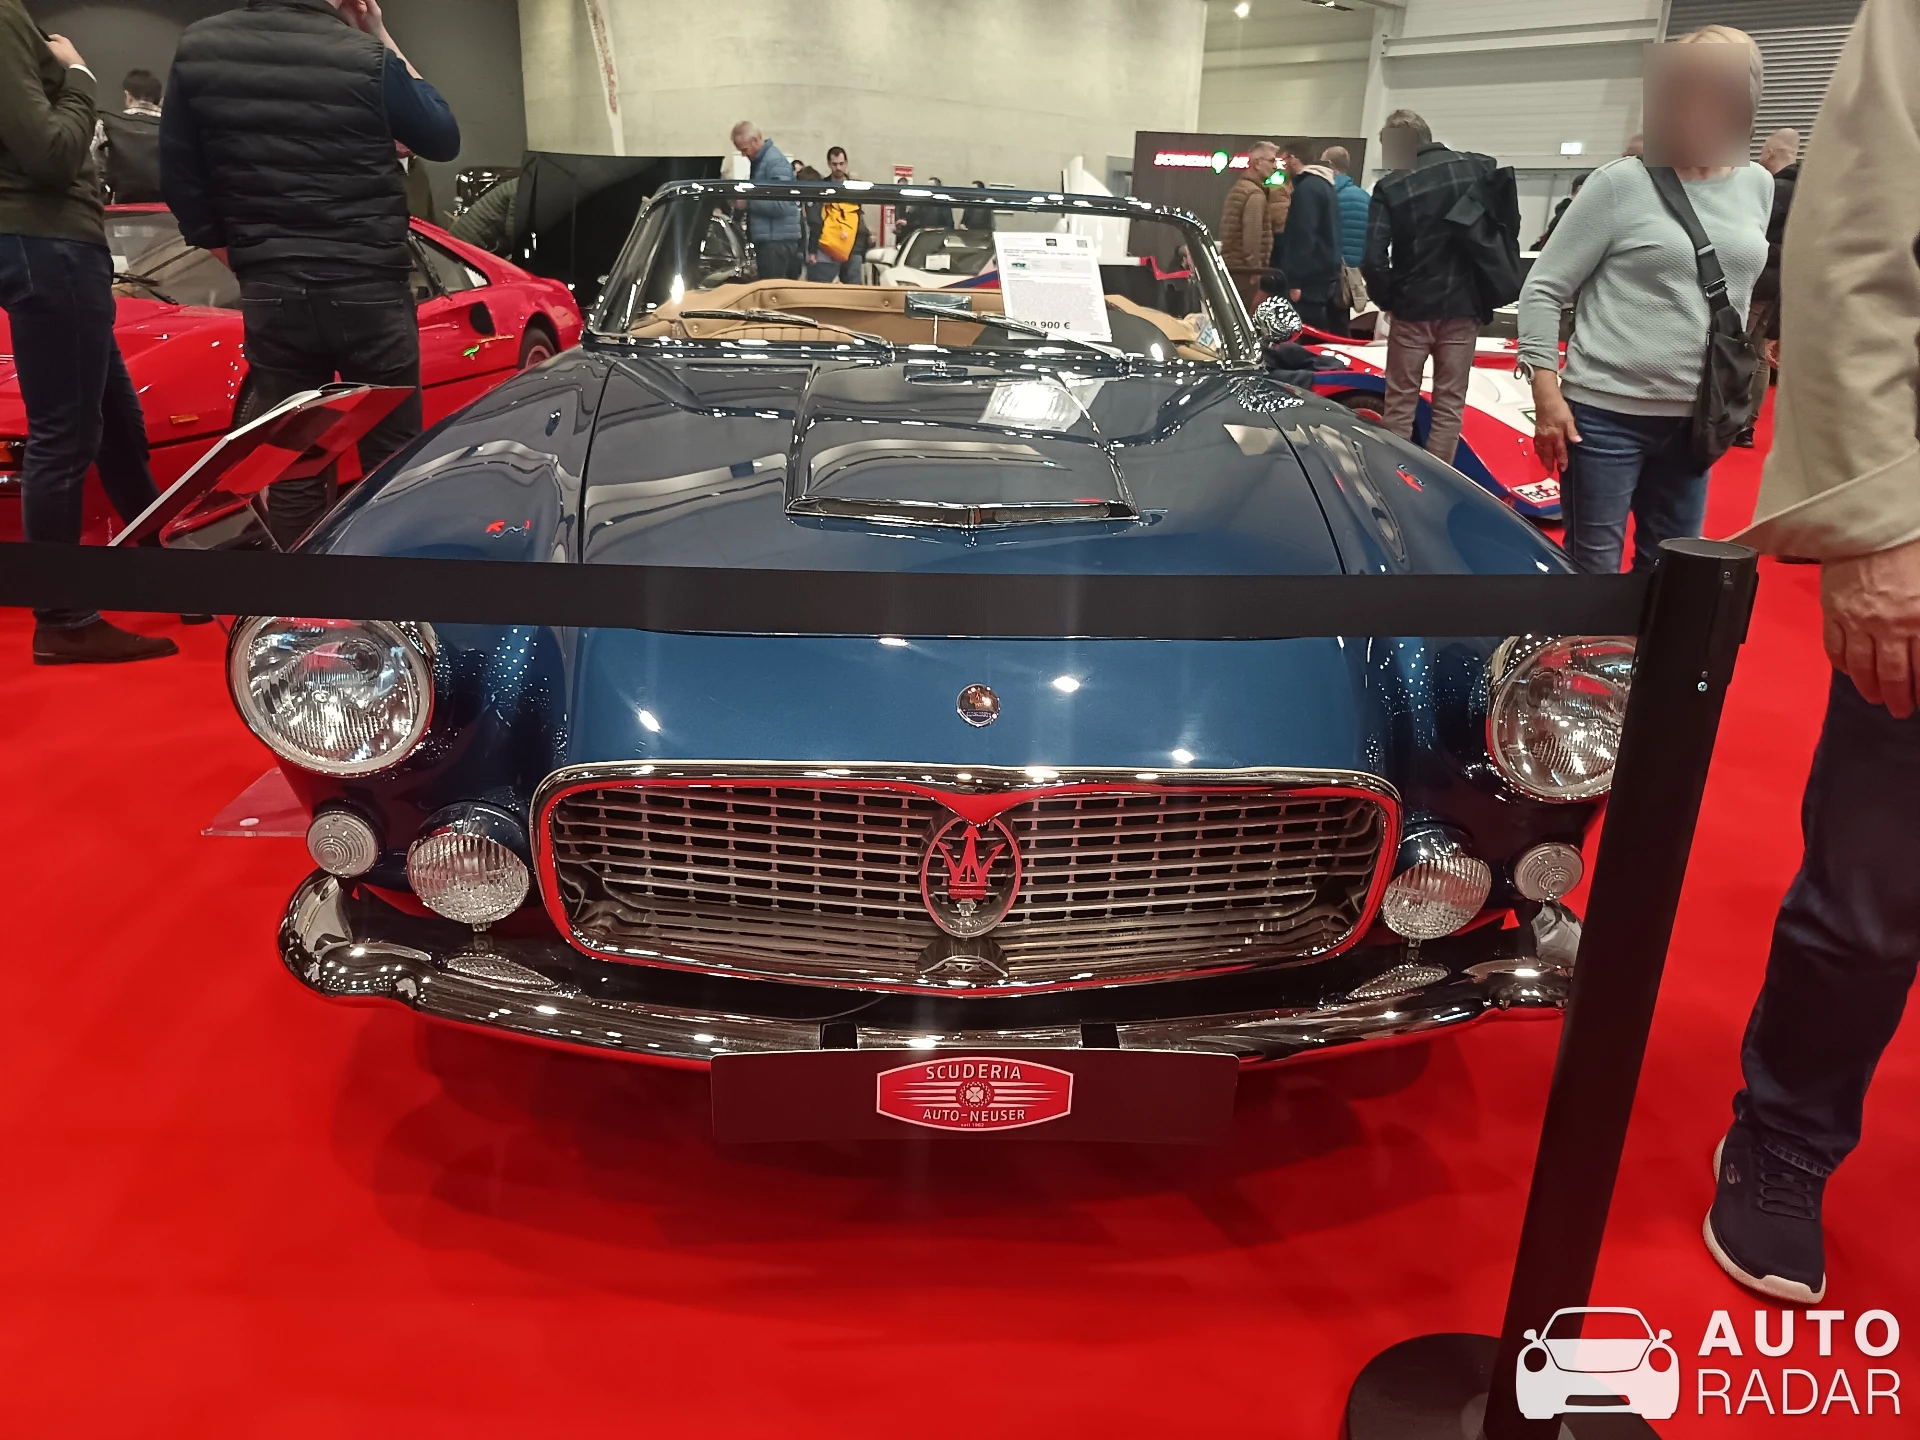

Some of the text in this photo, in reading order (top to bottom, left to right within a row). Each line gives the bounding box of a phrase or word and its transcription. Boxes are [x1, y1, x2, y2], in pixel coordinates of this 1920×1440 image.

[1040, 321, 1060, 329] 900
[926, 1063, 1021, 1080] SCUDERIA
[922, 1108, 1025, 1123] AUTO-NEUSER
